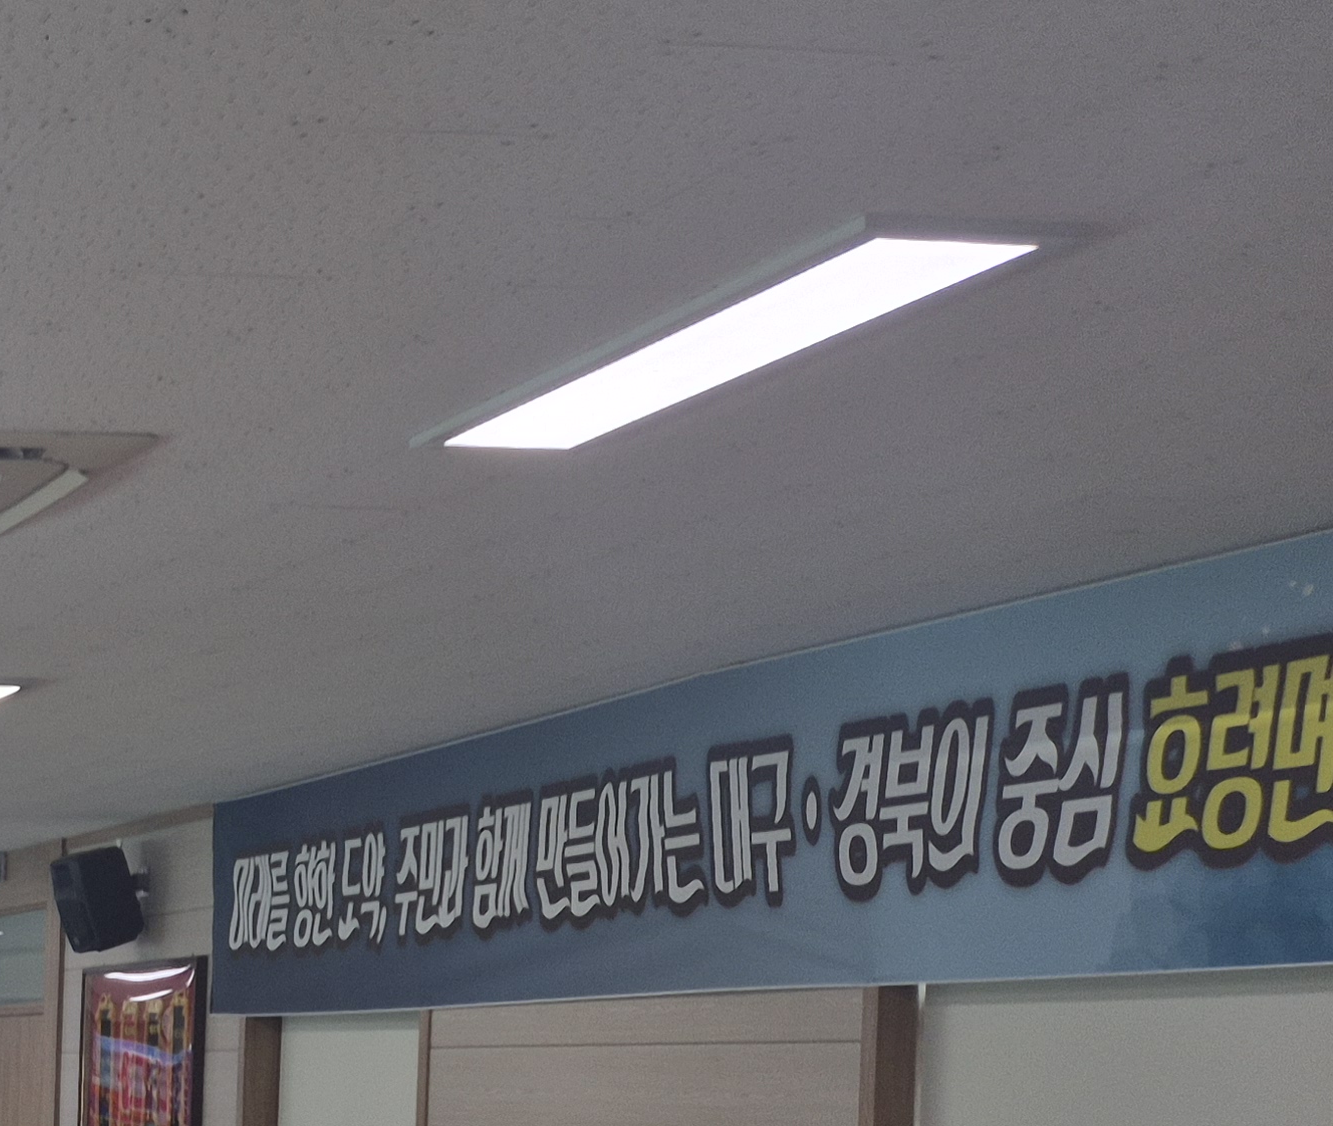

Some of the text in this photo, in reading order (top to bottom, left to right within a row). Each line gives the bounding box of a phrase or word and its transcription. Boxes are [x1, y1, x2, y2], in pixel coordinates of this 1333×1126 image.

[228, 849, 290, 952] 미래를
[293, 841, 335, 949] 향한
[396, 814, 470, 937] 주민과
[472, 801, 532, 930] 함께
[997, 691, 1123, 871] 중심
